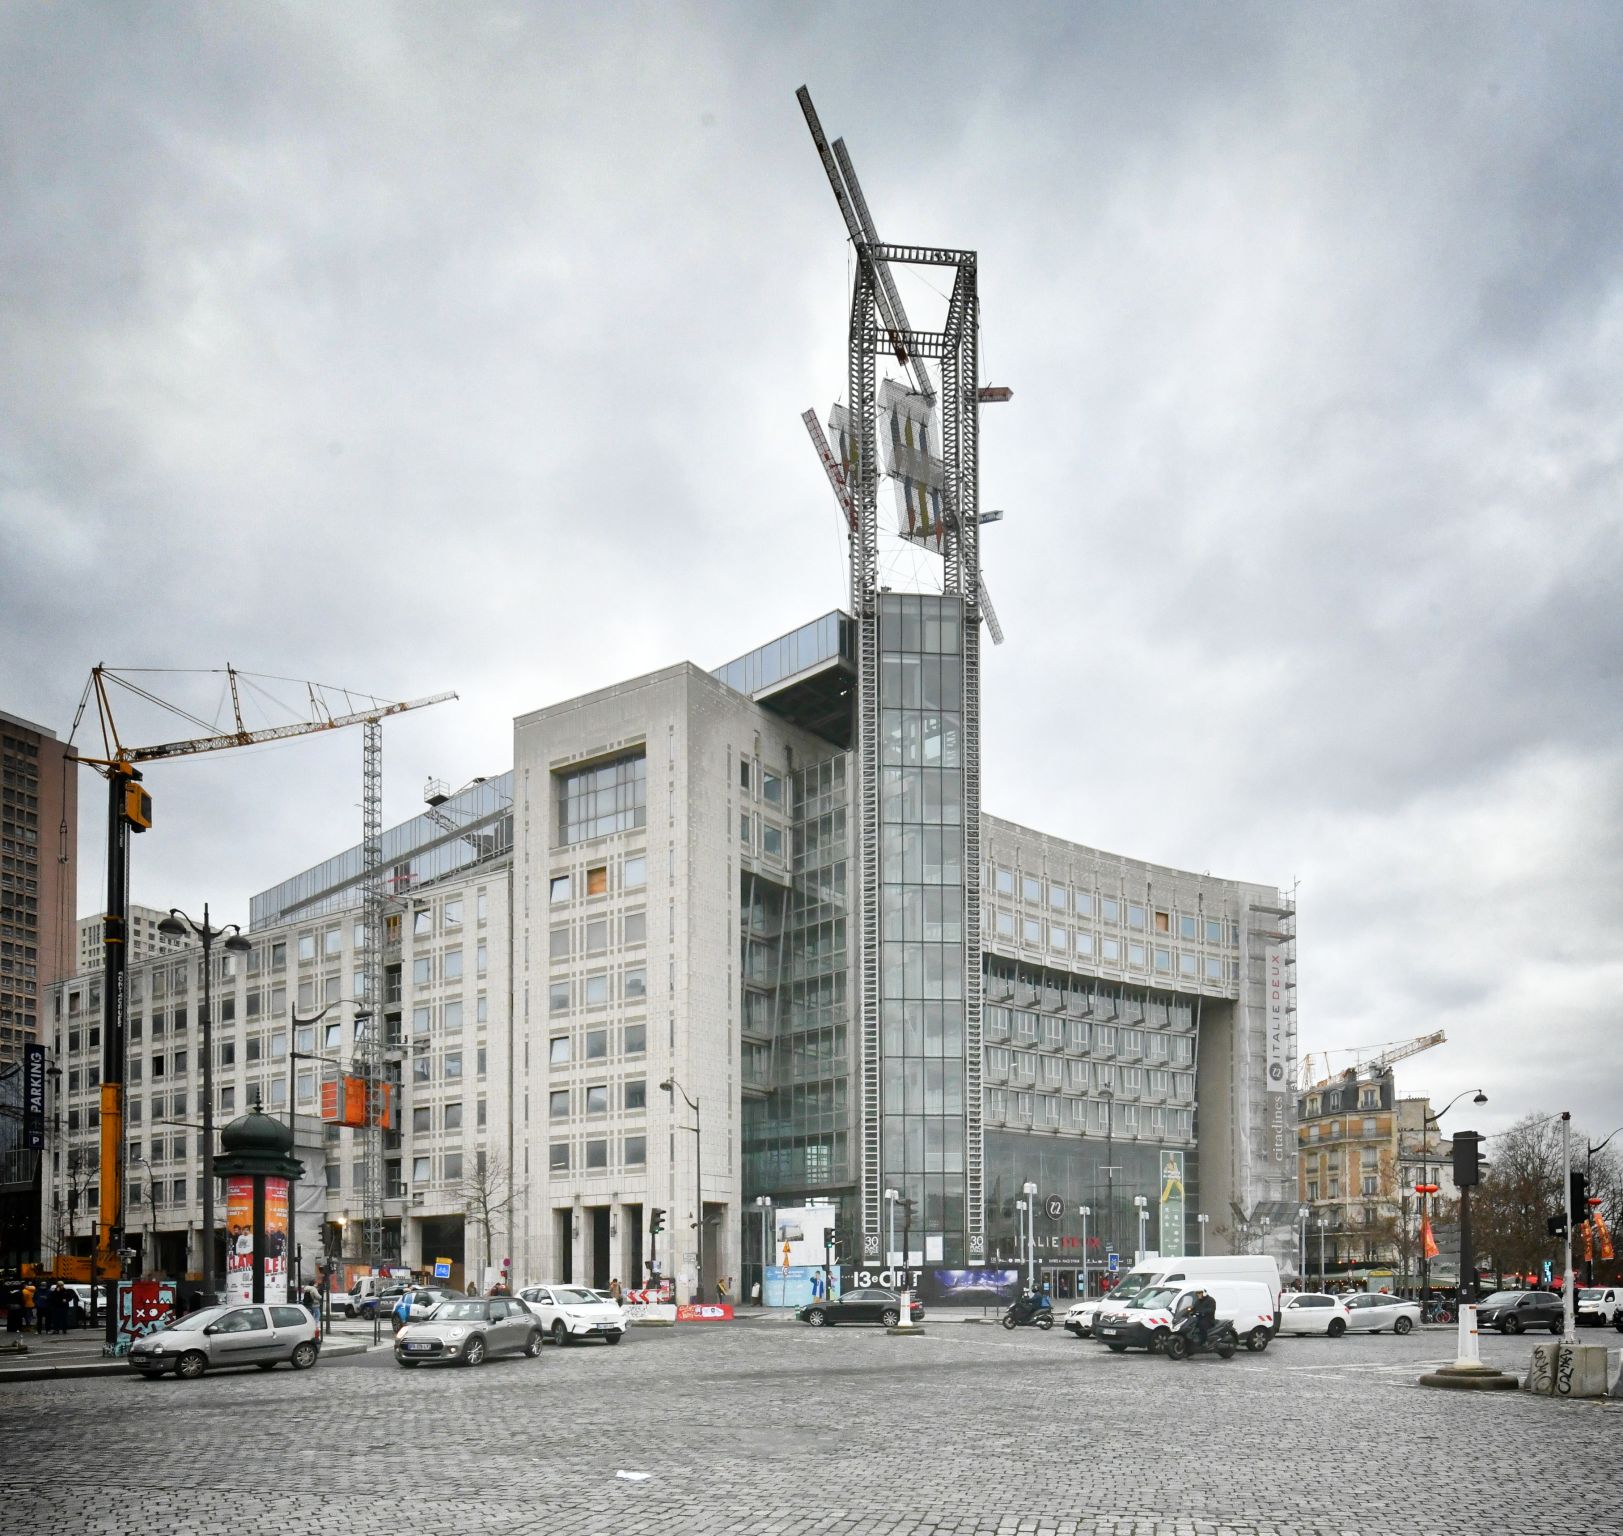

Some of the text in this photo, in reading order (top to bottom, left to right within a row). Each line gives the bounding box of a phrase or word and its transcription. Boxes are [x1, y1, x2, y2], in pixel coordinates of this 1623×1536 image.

[30, 1052, 42, 1113] PARKING
[1271, 1095, 1283, 1161] citadines
[865, 1236, 879, 1247] 30
[970, 1235, 984, 1246] 30
[265, 1256, 279, 1273] LE
